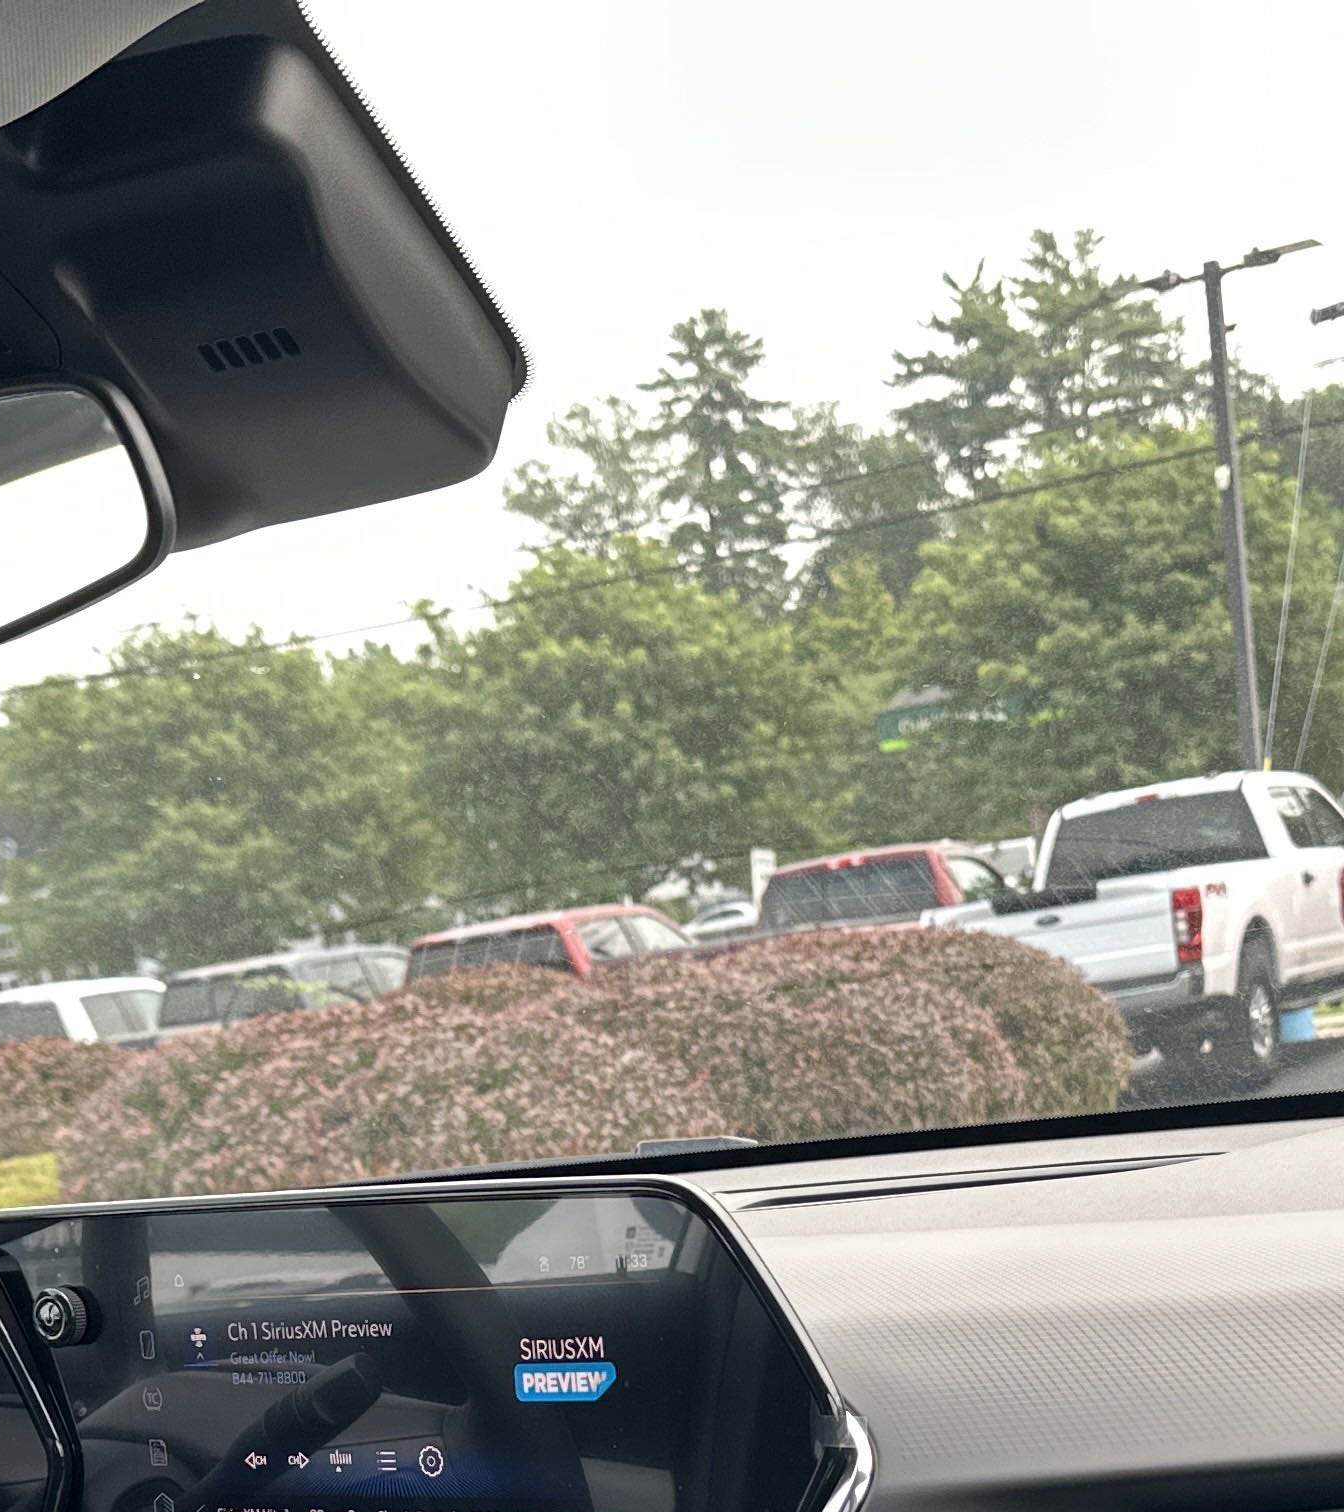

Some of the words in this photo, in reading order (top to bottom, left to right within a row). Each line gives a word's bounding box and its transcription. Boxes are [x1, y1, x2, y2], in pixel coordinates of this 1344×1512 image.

[227, 1322, 248, 1341] Ch
[251, 1322, 258, 1340] 1
[261, 1320, 328, 1341] SiriusXM
[331, 1319, 393, 1338] Preview
[230, 1352, 258, 1365] Great
[260, 1351, 288, 1364] Offer
[520, 1336, 604, 1360] SIRIUSXM
[232, 1371, 306, 1385] 844-711-8800
[522, 1371, 607, 1393] PREVIEW
